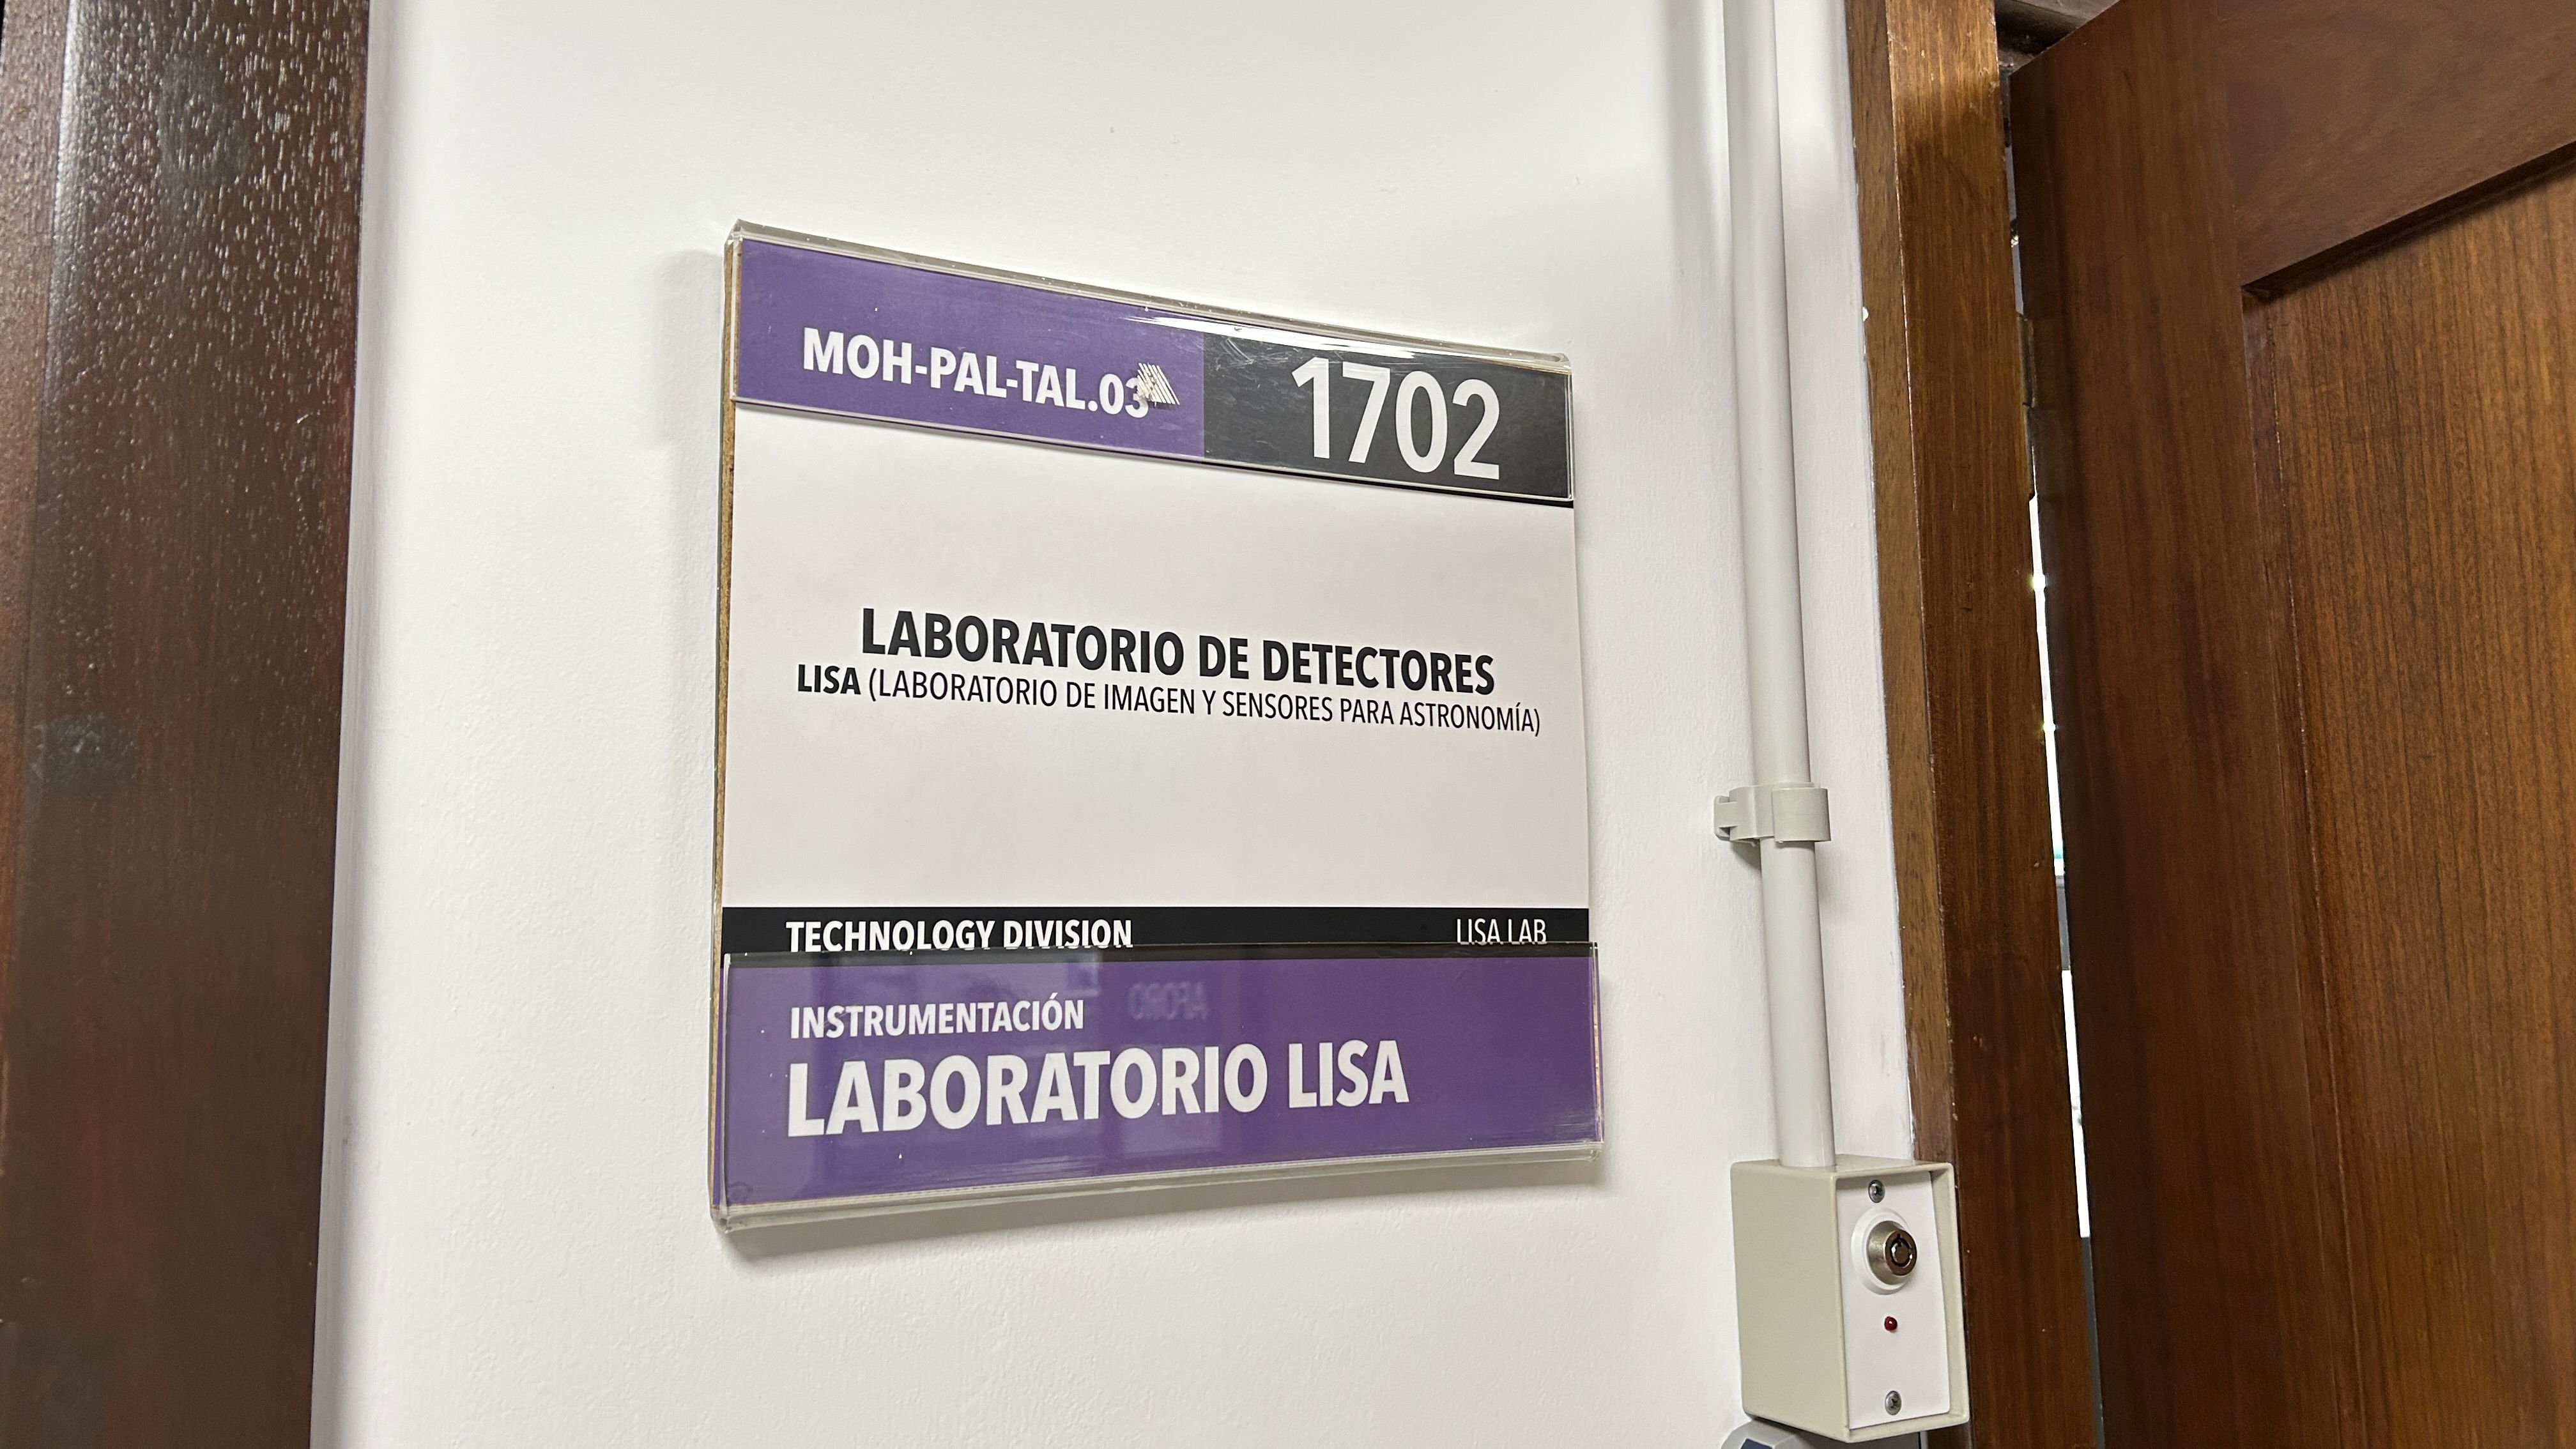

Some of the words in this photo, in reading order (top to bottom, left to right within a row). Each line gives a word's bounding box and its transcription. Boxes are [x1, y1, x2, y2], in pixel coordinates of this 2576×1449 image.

[803, 326, 1149, 418] MOH-PAL-TAL.03
[1291, 356, 1500, 480] 1702
[862, 608, 1184, 676] LABORATORIO
[1199, 634, 1250, 680] DE
[1262, 640, 1495, 695] DETECTORES
[797, 664, 861, 695] LISA
[869, 668, 1057, 707] (LABORATORIO
[1066, 681, 1096, 709] DE
[1104, 684, 1195, 714] IMAGEN
[1202, 689, 1216, 715] Y
[1222, 691, 1333, 722] SENSORES
[1340, 698, 1395, 725] PARA
[1399, 702, 1540, 737] ASTRONOMÍA)
[785, 919, 995, 953] TECHNOLOGY
[1003, 919, 1133, 949] DIVISION
[1457, 918, 1503, 945] LISA
[1508, 919, 1547, 945] LAB
[790, 992, 1084, 1039] INSTRUMENTACIÓN
[787, 1043, 1268, 1137] LABORATORIO
[1289, 1039, 1409, 1108] LISA
